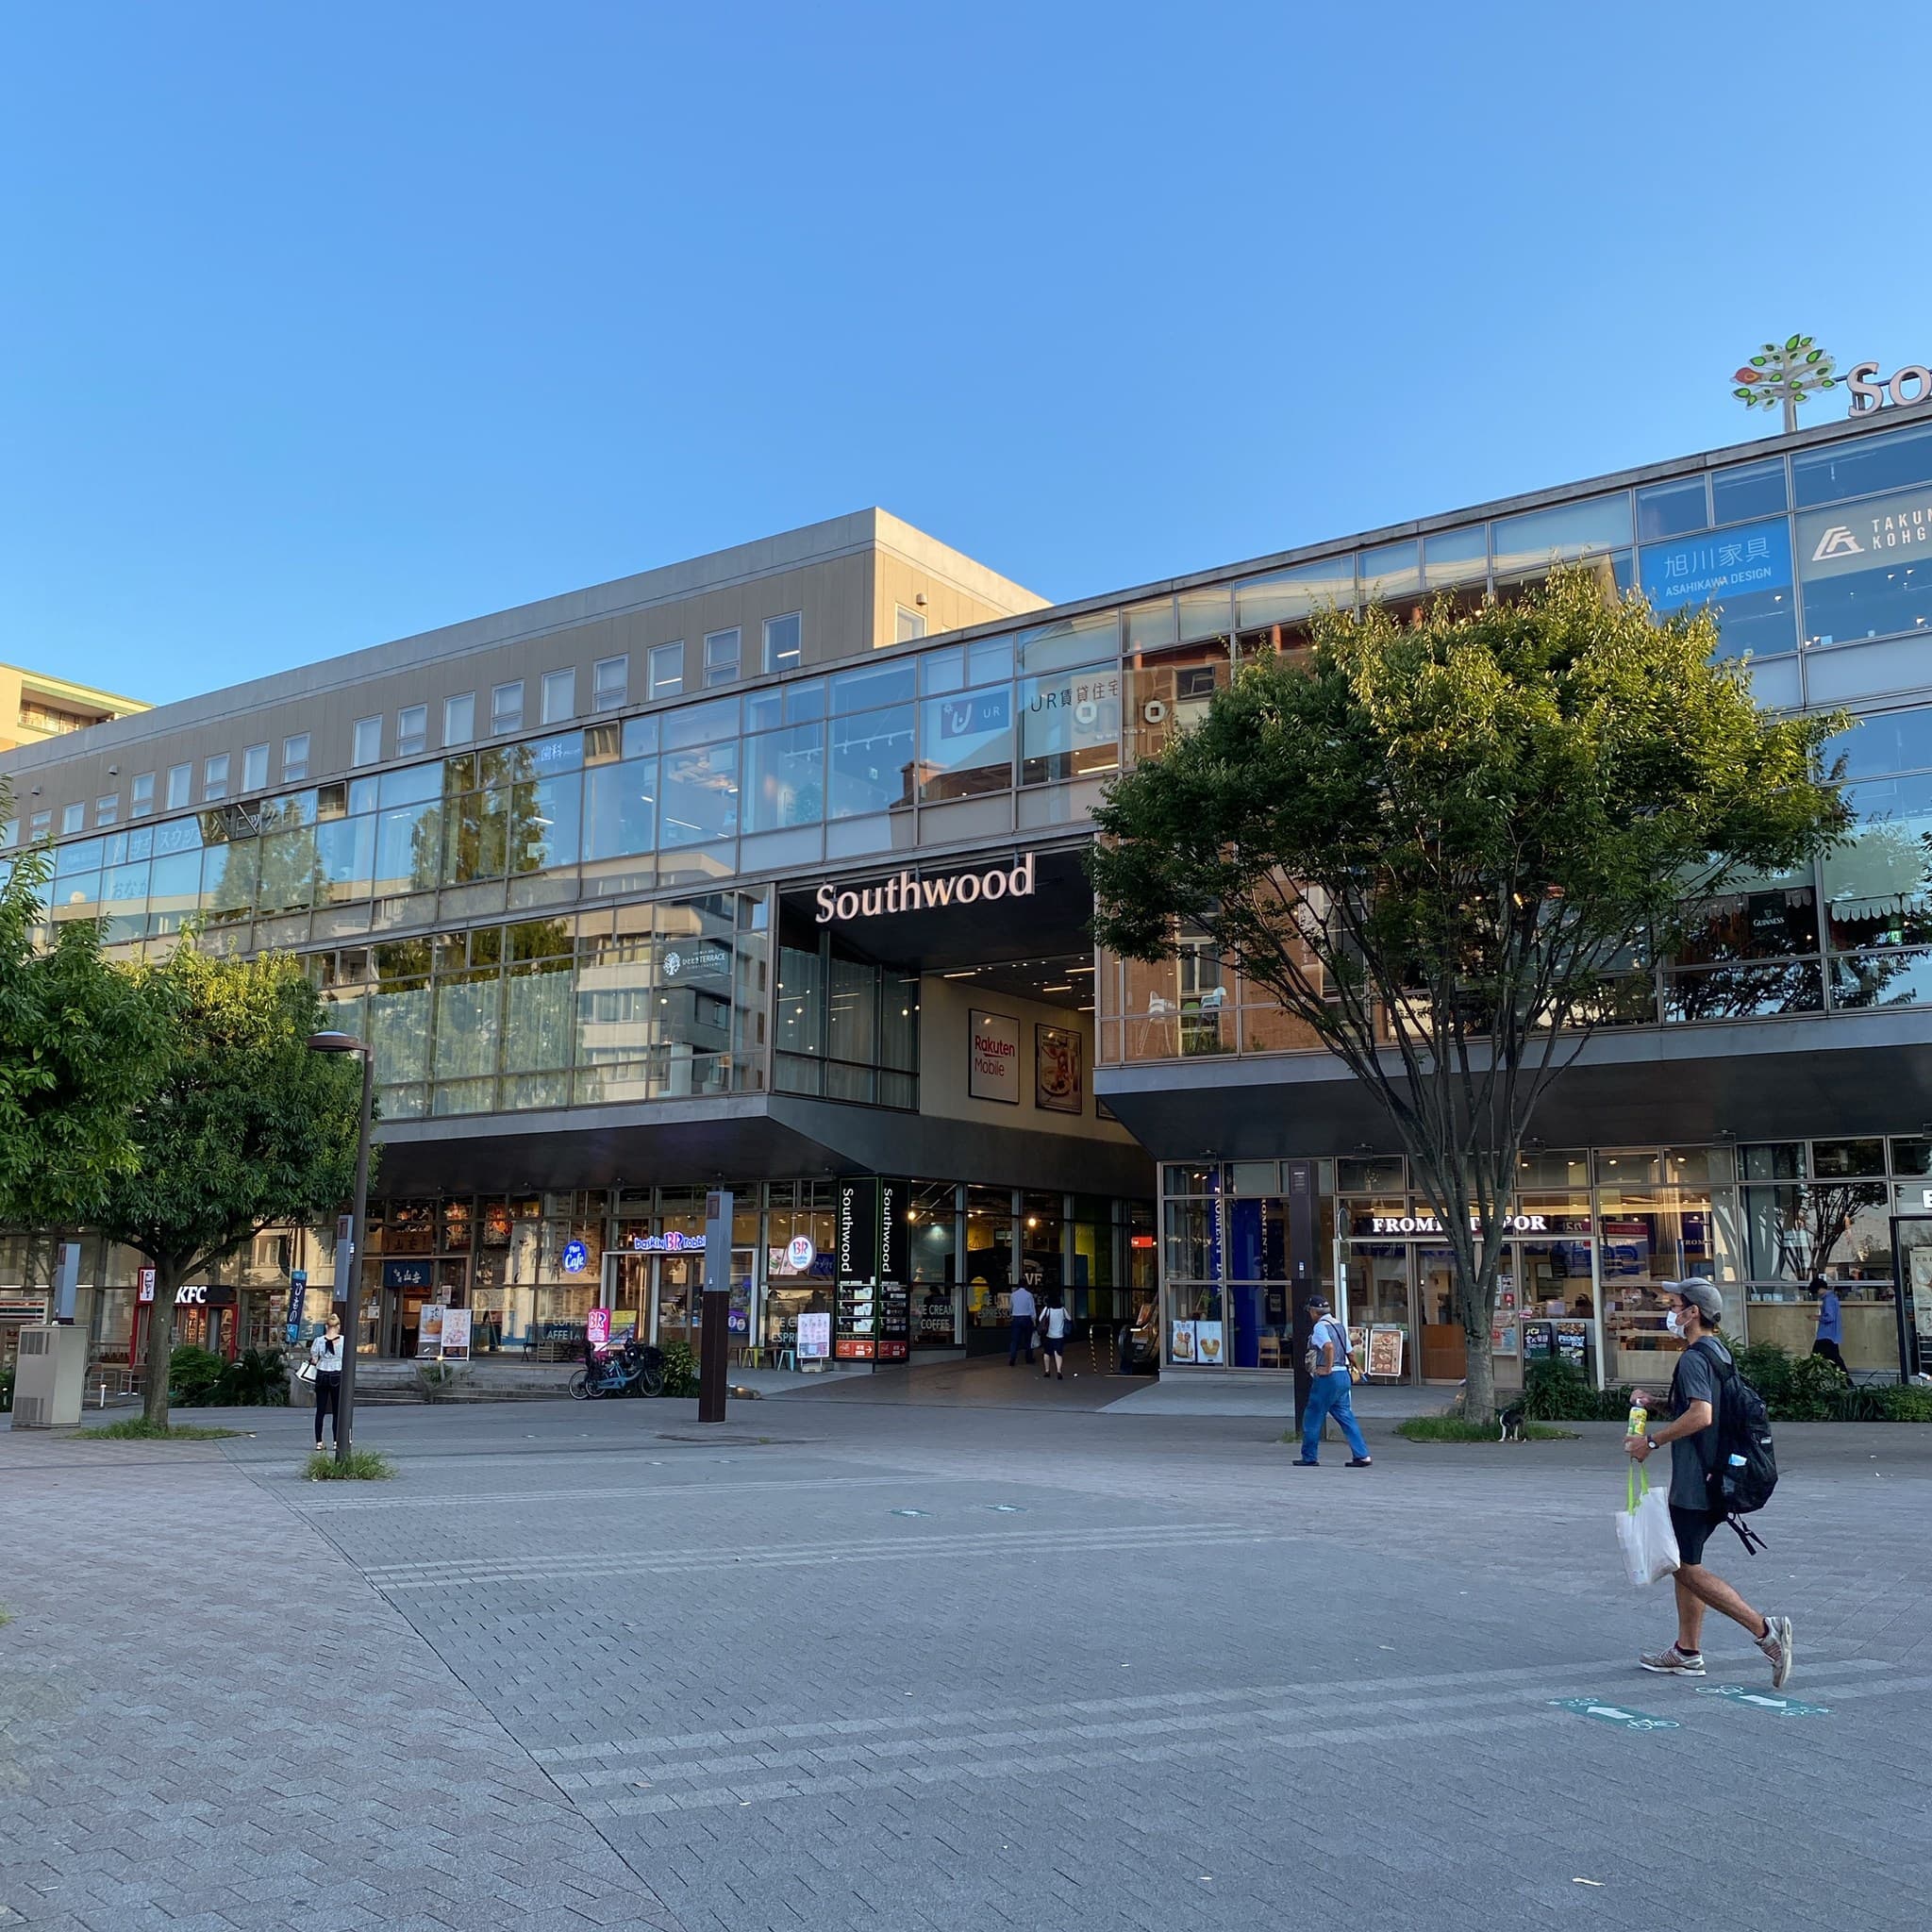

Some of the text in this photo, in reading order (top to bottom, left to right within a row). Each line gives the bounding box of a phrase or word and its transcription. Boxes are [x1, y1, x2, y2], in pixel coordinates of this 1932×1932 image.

[1664, 536, 1771, 579] 旭川家具
[1665, 567, 1772, 597] ASAHIKAWA DESIGN
[983, 706, 1000, 719] UR
[815, 852, 1036, 924] Southwood
[974, 1034, 1016, 1058] Rakuten
[974, 1057, 1005, 1077] Mobile
[841, 1188, 854, 1273] Southwood
[882, 1188, 893, 1273] Southwood
[1372, 1216, 1479, 1233] FROMT
[1502, 1215, 1547, 1231] 'OR
[634, 1231, 706, 1251] baskin BR robbi
[792, 1241, 808, 1255] BR
[565, 1252, 585, 1271] Cafe
[175, 1286, 208, 1304] KFC
